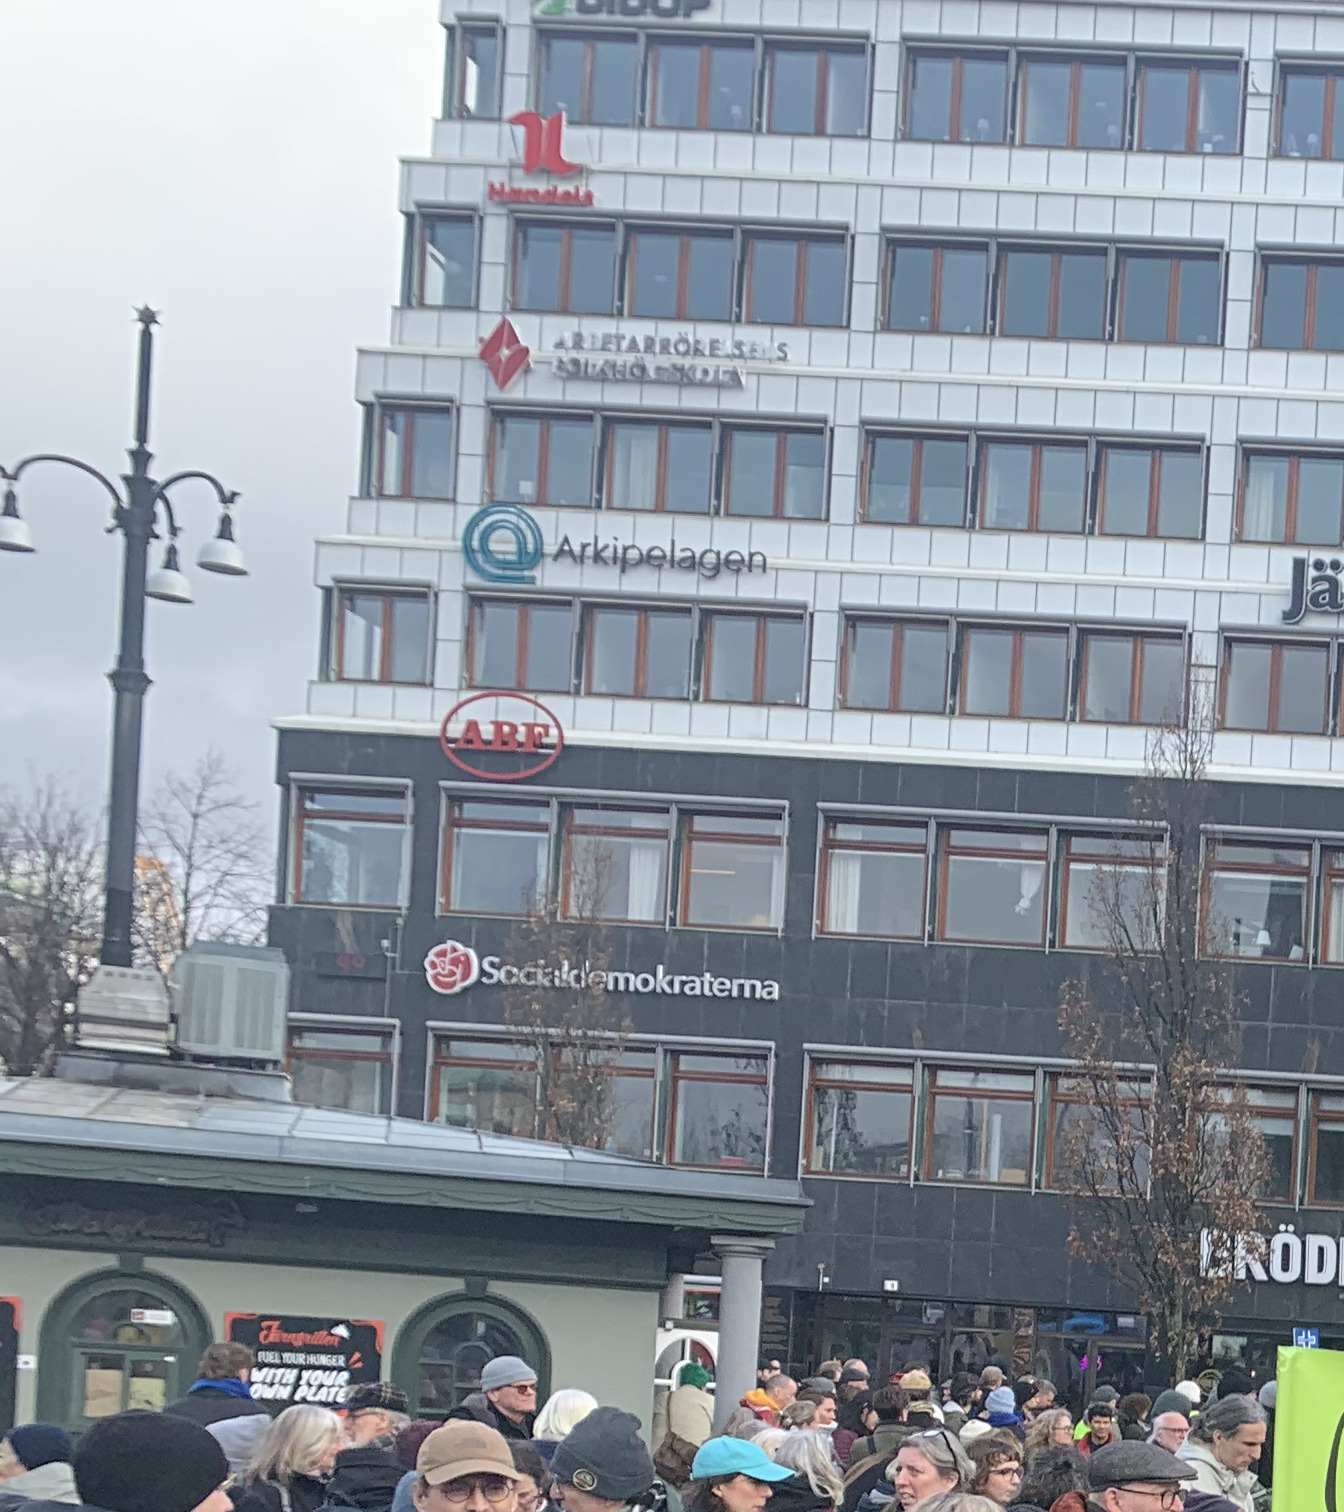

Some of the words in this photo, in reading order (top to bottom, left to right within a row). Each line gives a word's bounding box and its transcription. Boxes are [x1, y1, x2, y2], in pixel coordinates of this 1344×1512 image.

[552, 533, 768, 579] Arkipelagen
[454, 718, 550, 753] ABF
[480, 954, 780, 1001] Socialdemokraterna
[257, 1350, 281, 1365] FUEL
[281, 1351, 306, 1366] YOUR
[306, 1353, 346, 1368] HUNGER
[250, 1367, 298, 1385] WITH
[299, 1369, 351, 1387] YOUR
[250, 1383, 292, 1400] OWN
[293, 1384, 347, 1404] PLATE
